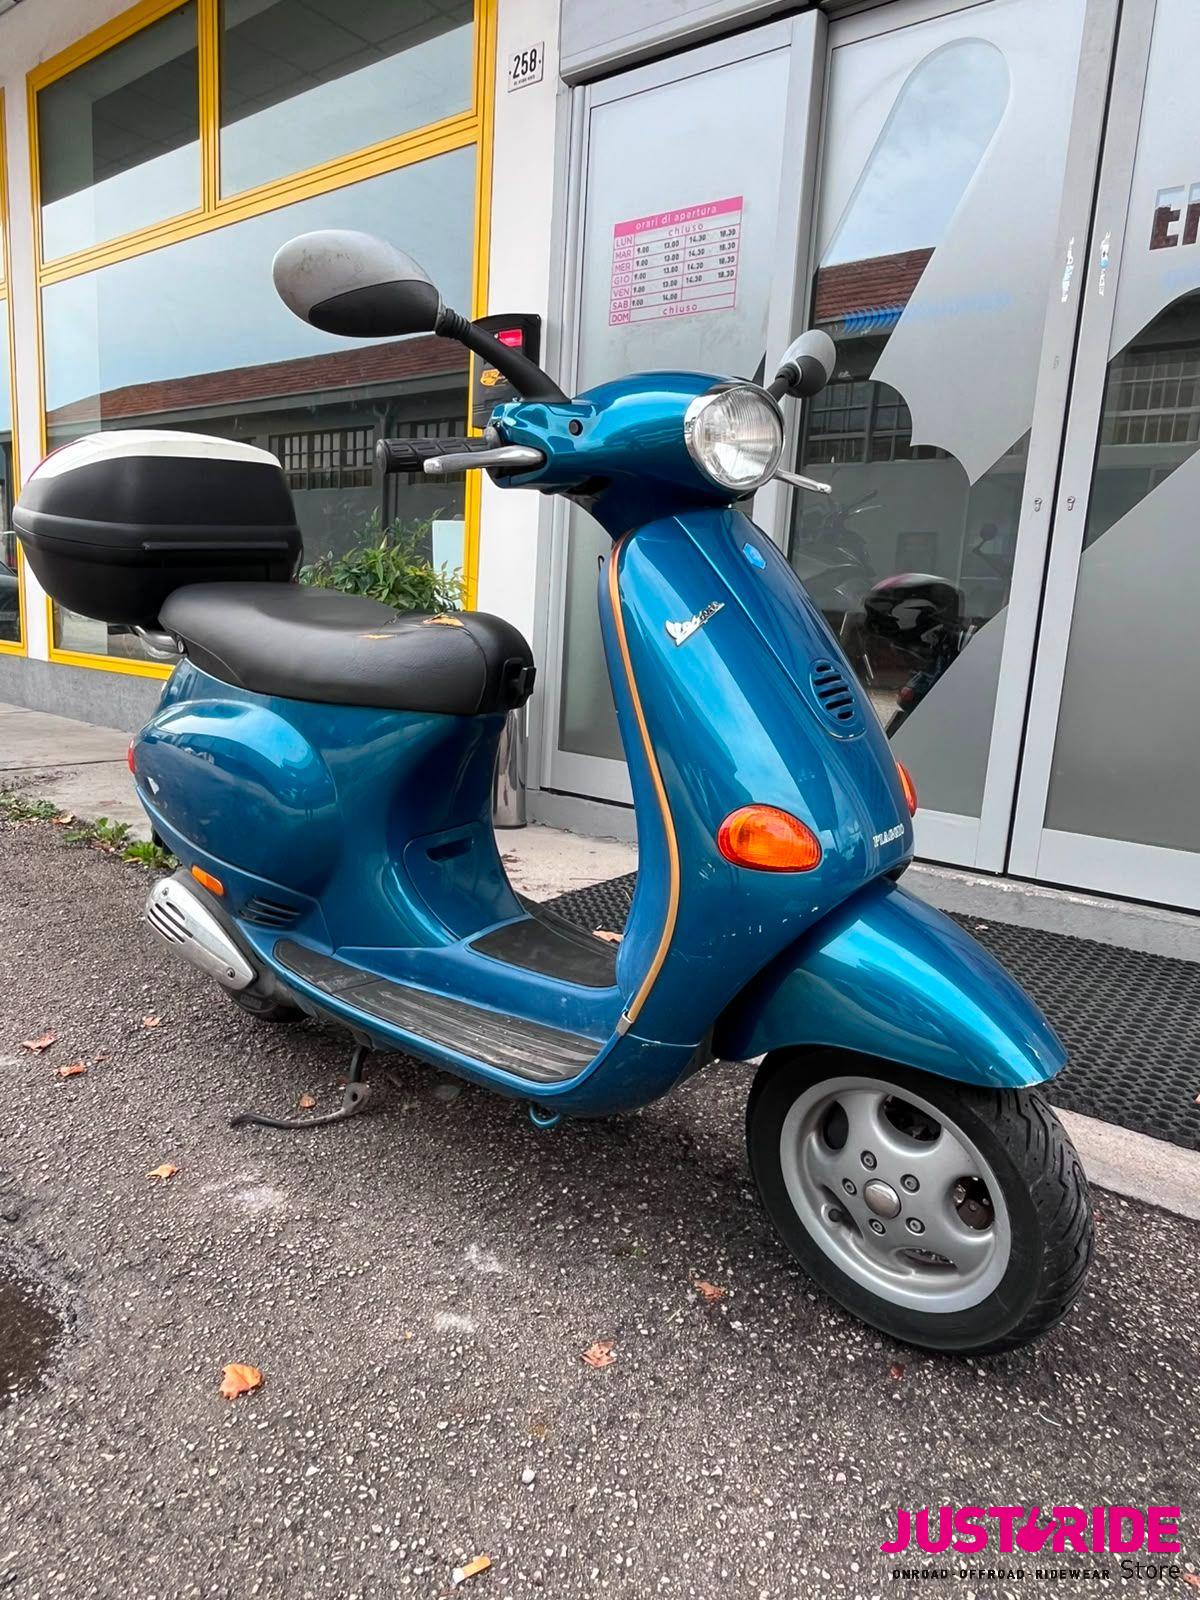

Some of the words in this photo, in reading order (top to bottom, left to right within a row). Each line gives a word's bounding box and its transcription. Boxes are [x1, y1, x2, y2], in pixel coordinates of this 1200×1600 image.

[513, 48, 537, 79] 258
[635, 218, 658, 230] orari
[661, 214, 671, 224] di
[674, 204, 717, 222] apertura
[668, 223, 704, 236] chiuso
[616, 237, 633, 247] LUN
[615, 249, 632, 259] MAR
[615, 262, 631, 272] MER
[614, 274, 630, 285] GIO
[613, 287, 630, 297] VEN
[612, 299, 629, 310] SAB
[662, 304, 698, 315] chiuso
[611, 313, 629, 323] DOM
